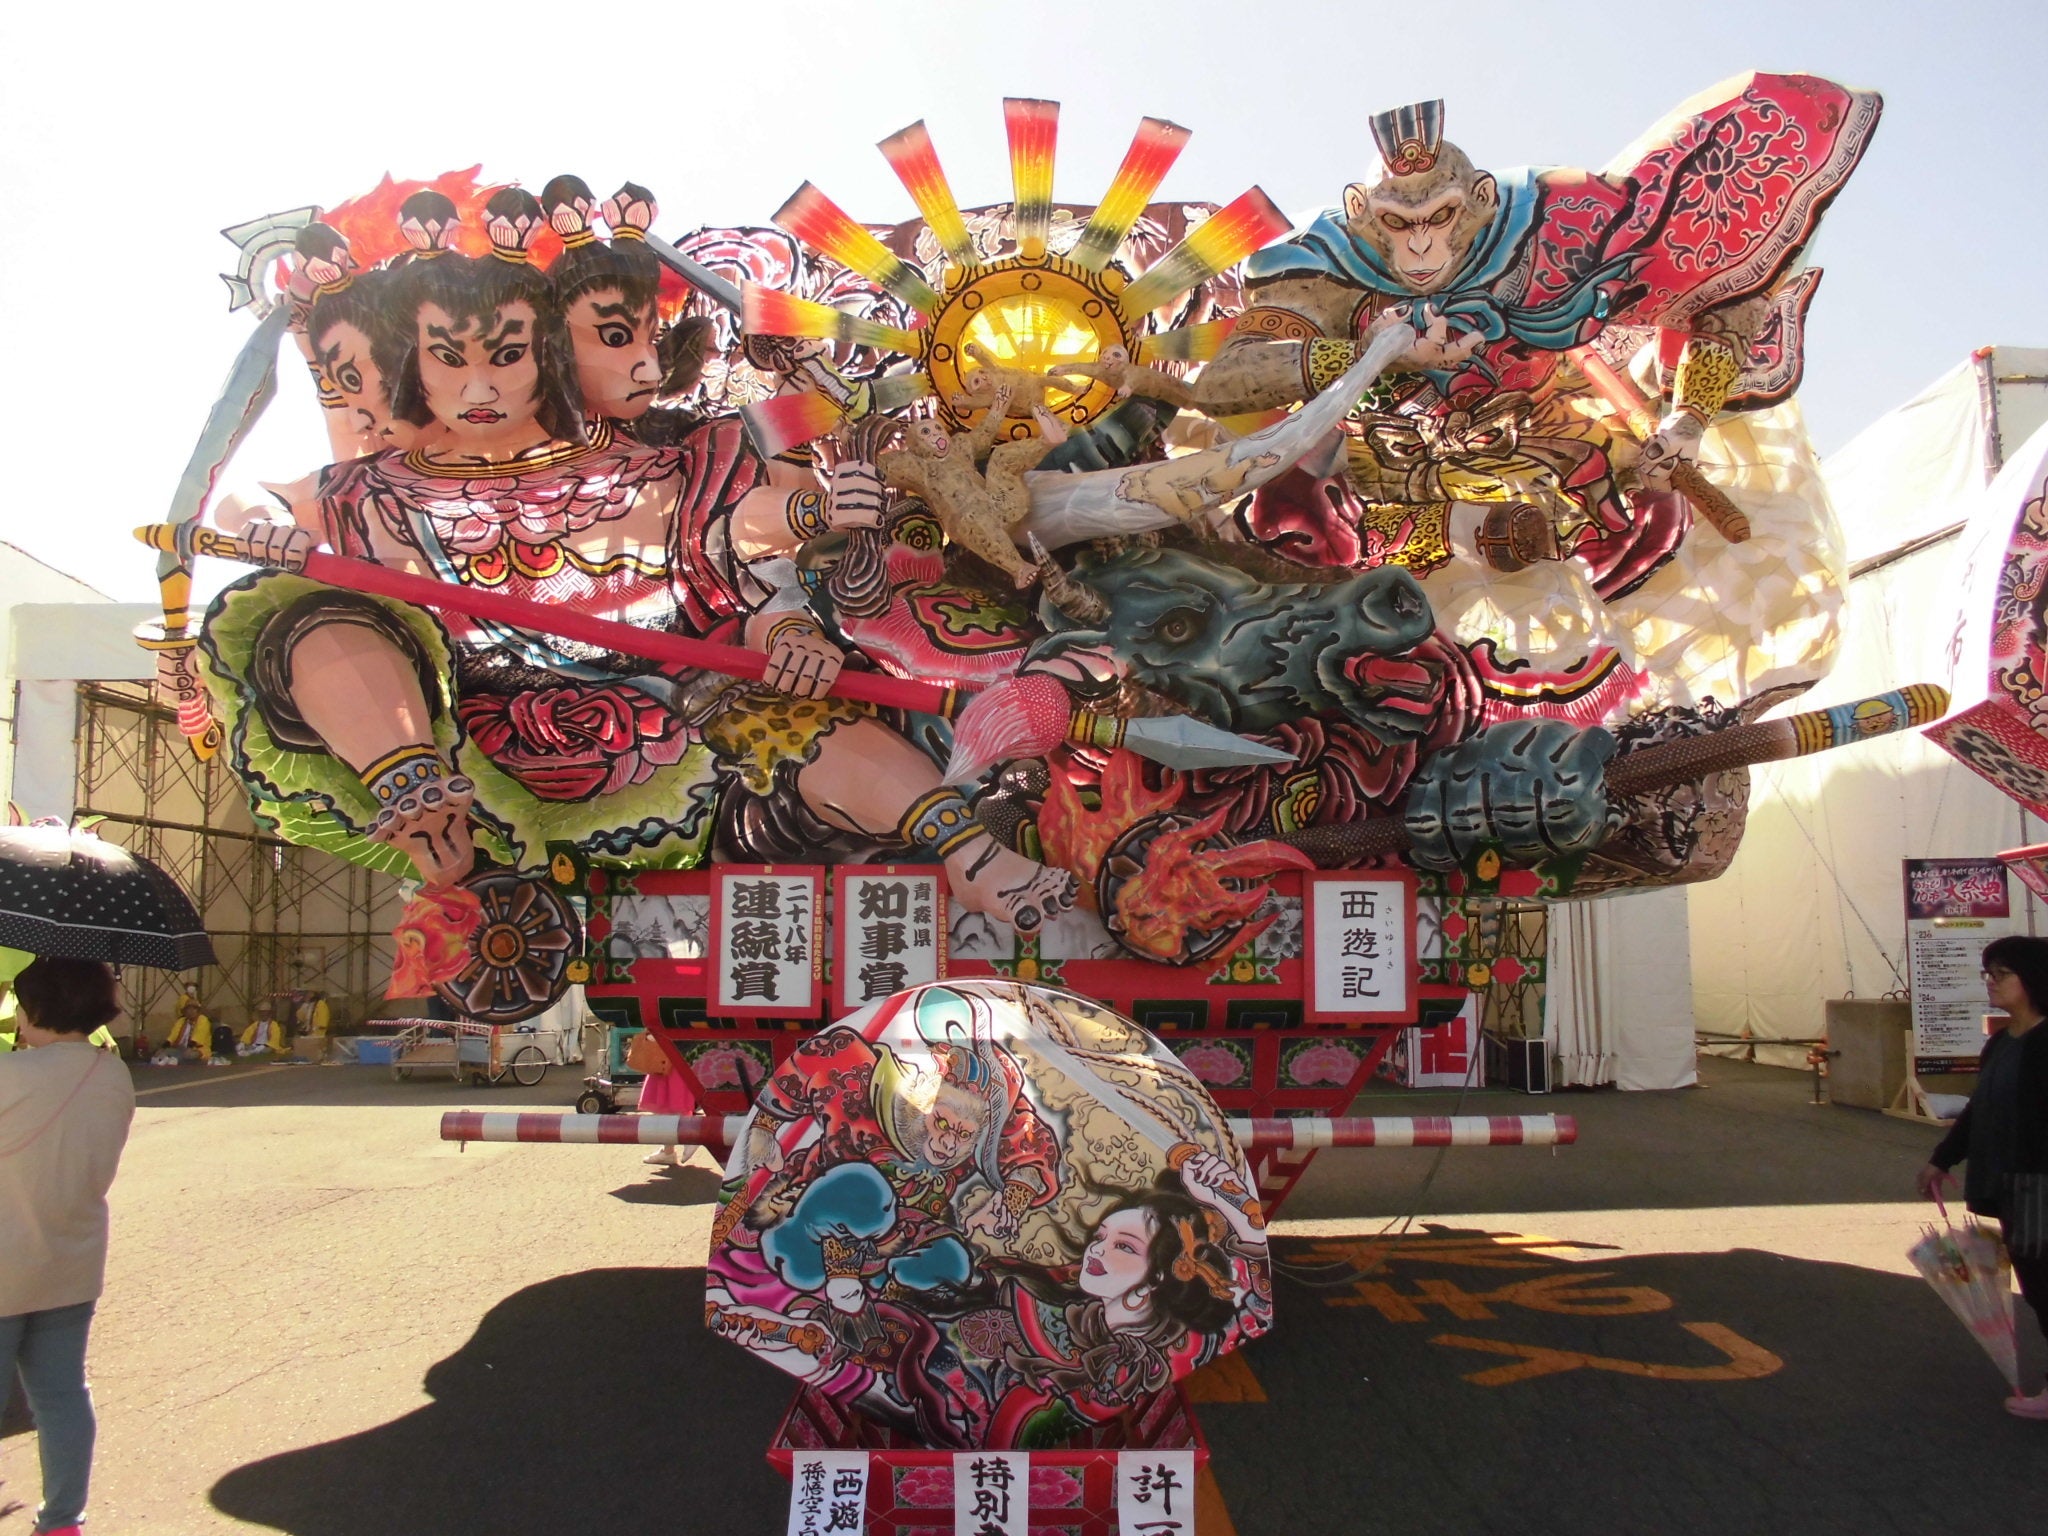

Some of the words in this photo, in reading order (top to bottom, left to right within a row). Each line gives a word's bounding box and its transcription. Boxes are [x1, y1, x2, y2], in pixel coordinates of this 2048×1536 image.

[784, 884, 808, 965] 二十八年
[913, 882, 931, 947] 青森県
[1943, 873, 2002, 903] 大祭典
[731, 880, 782, 1001] 連続賞
[858, 880, 909, 1001] 知事賞
[1340, 890, 1380, 998] 西遊記
[1385, 905, 1394, 969] さいゆうき
